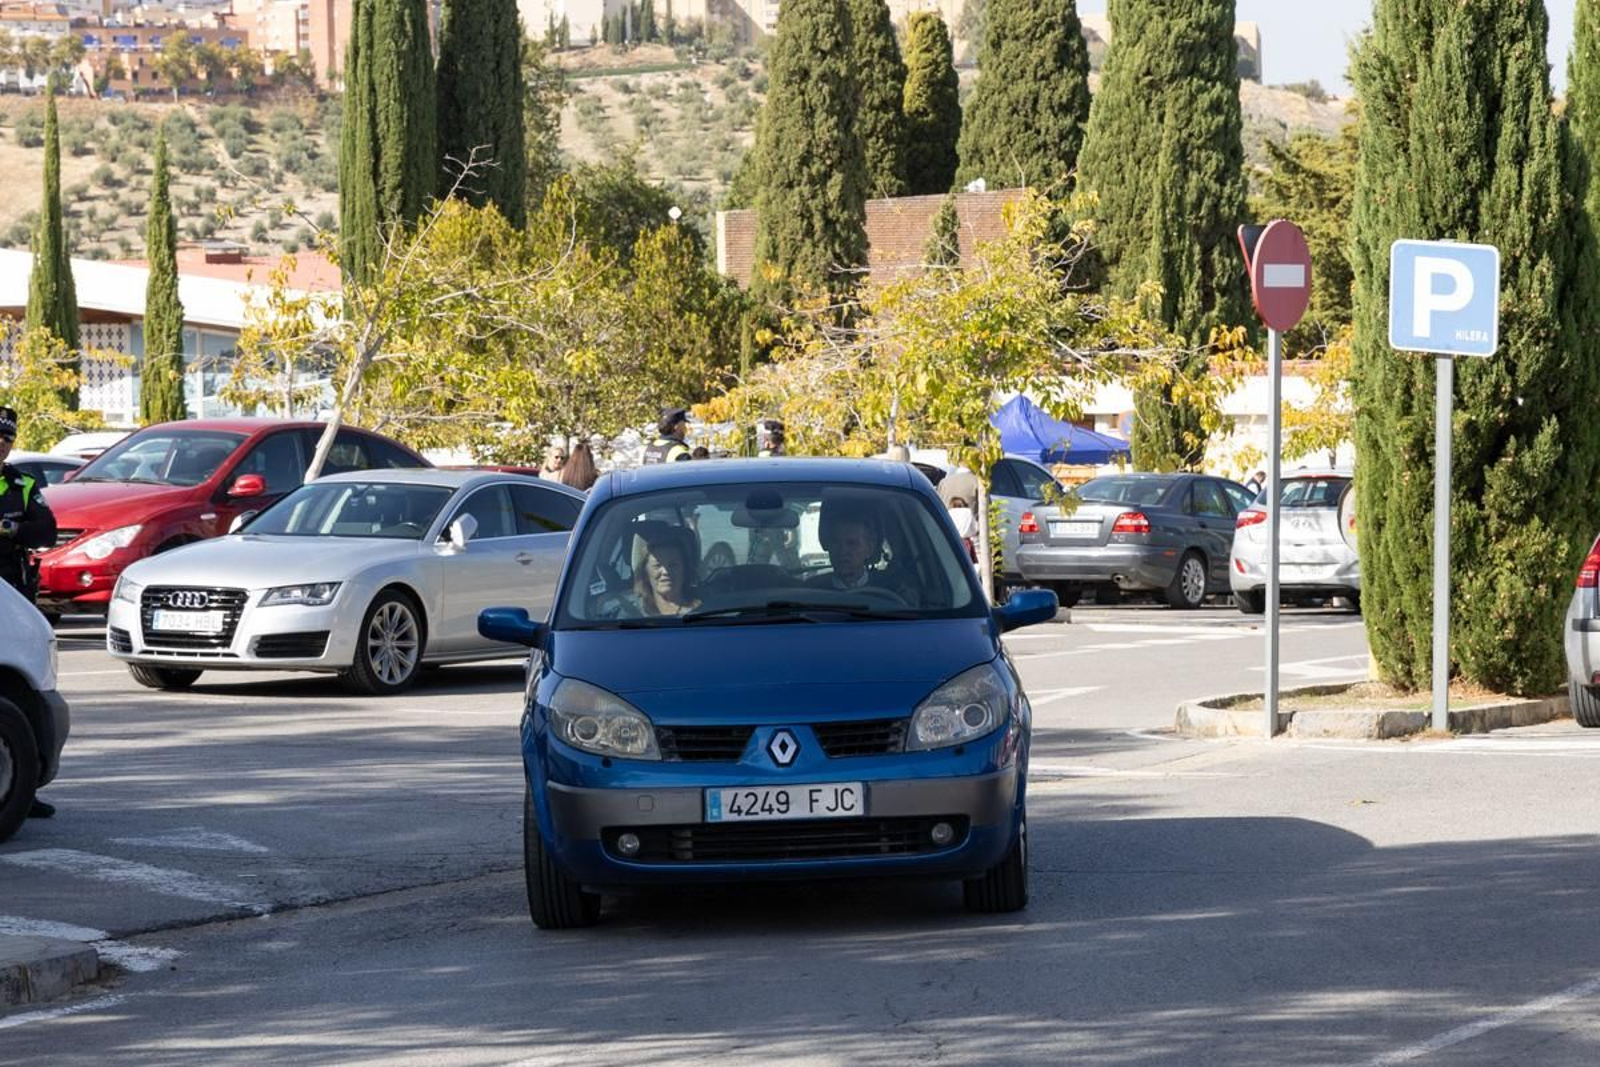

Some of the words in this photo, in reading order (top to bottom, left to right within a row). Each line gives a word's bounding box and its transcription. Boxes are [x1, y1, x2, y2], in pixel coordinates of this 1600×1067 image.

[1413, 256, 1474, 337] P
[729, 790, 790, 816] 4249
[809, 787, 855, 813] FJC
